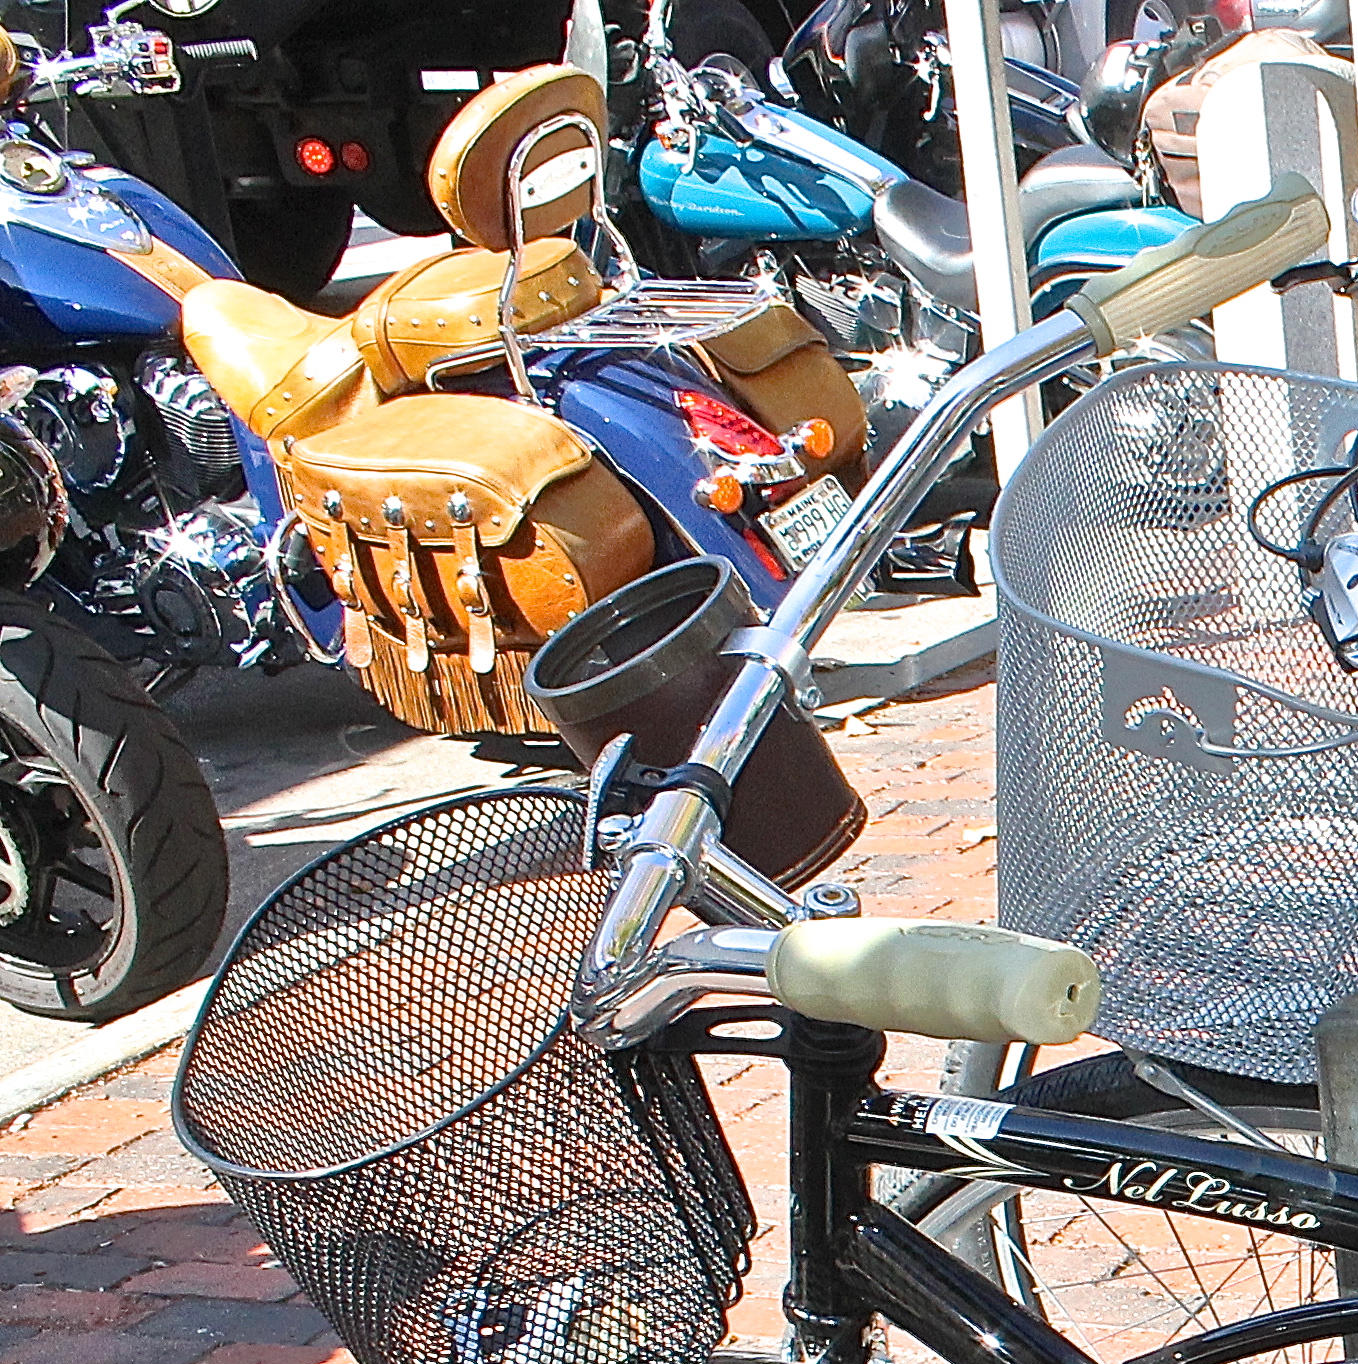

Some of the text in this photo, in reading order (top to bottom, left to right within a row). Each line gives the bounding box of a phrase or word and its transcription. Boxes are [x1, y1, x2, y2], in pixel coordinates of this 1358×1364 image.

[787, 494, 819, 517] MAINE
[1063, 1160, 1322, 1232] Nel Lusso
